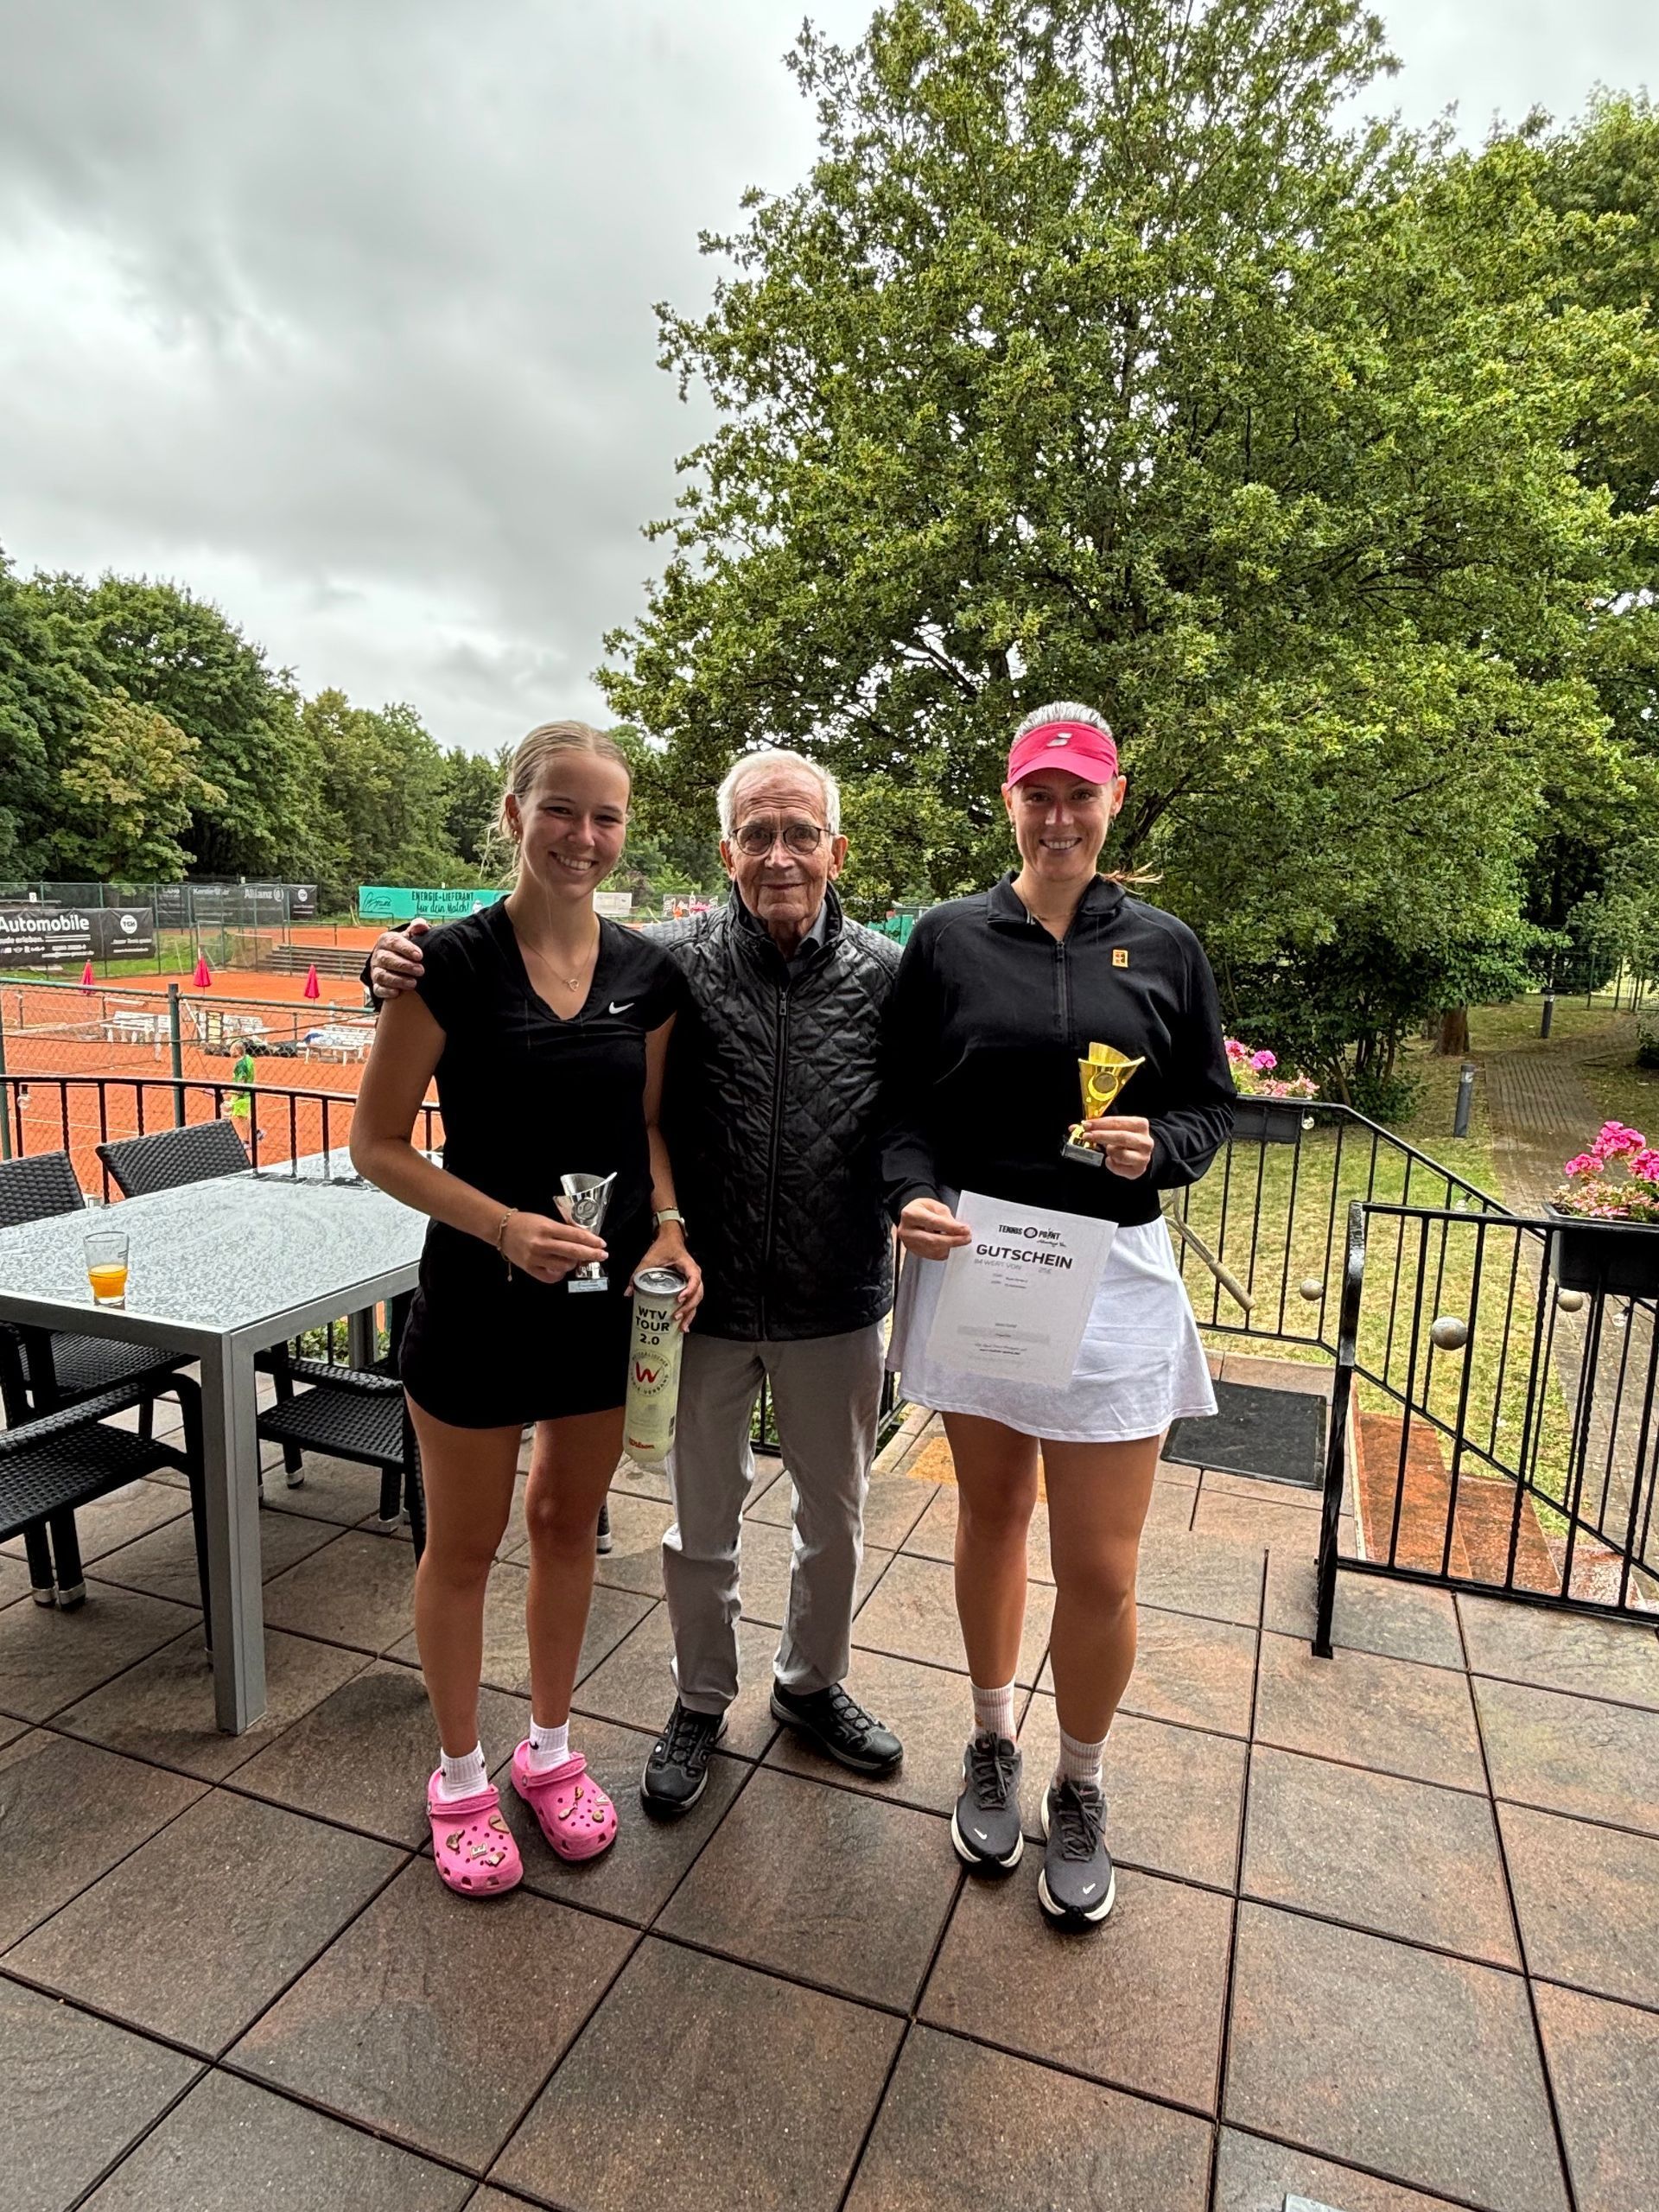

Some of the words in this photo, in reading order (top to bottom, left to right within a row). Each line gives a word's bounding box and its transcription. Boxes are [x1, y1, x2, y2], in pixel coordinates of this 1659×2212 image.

[411, 891, 474, 902] ENERGIE-LIEFERANT
[0, 914, 90, 933] Automobile
[976, 1243, 1073, 1269] GUTSCHEIN
[1006, 1262, 1022, 1271] VON
[638, 1306, 667, 1320] WTV
[635, 1315, 670, 1332] TOUR
[639, 1333, 660, 1345] 2.0
